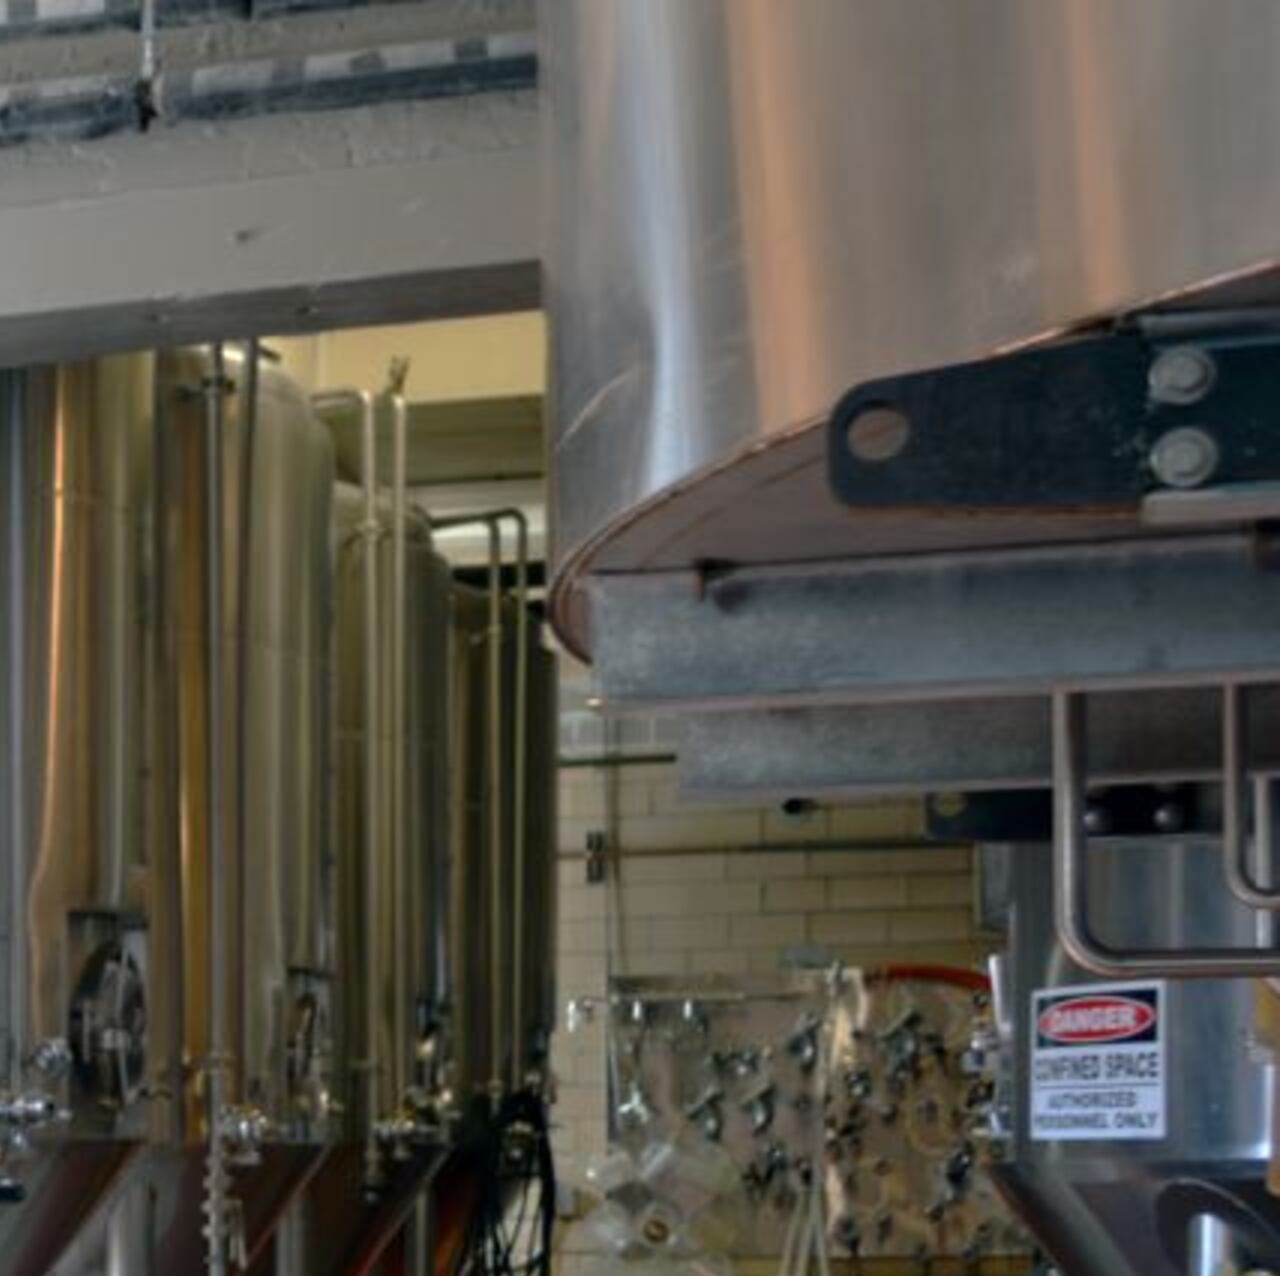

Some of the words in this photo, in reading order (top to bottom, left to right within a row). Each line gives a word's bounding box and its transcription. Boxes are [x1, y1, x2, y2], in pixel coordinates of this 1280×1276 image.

[1048, 1005, 1137, 1032] DANGER
[1105, 1052, 1159, 1078] SPACE
[1113, 1112, 1158, 1129] ONLY
